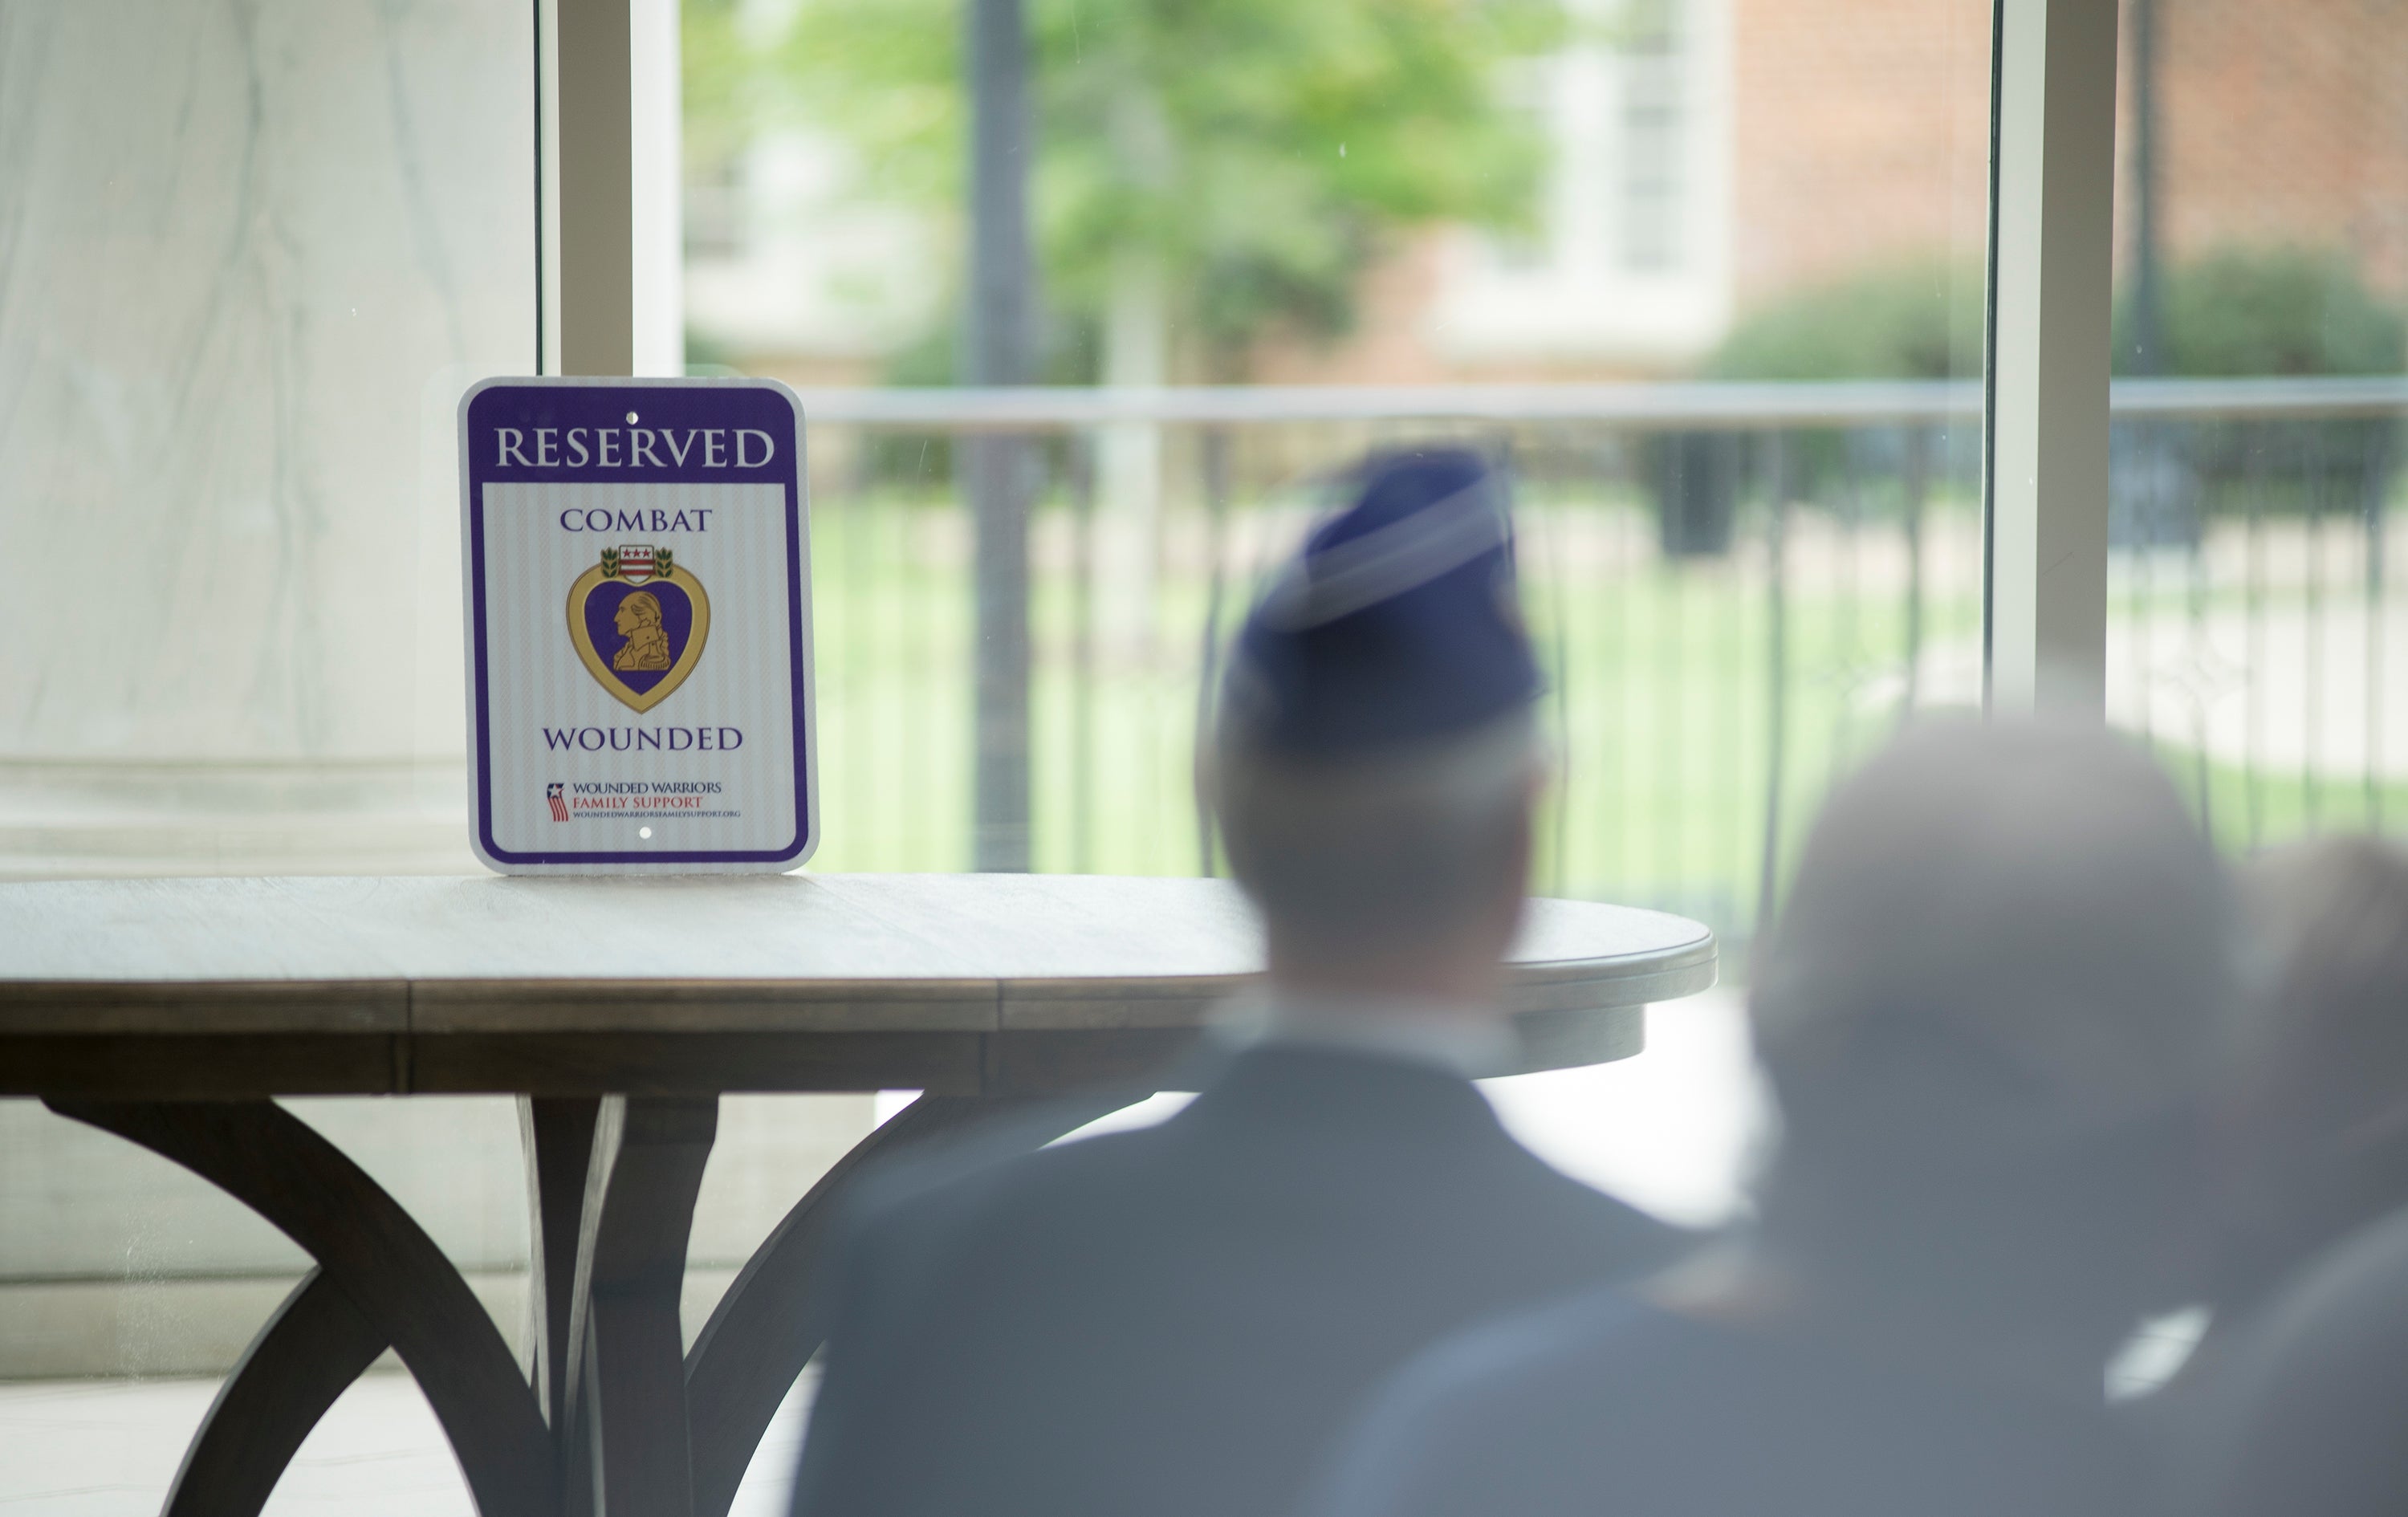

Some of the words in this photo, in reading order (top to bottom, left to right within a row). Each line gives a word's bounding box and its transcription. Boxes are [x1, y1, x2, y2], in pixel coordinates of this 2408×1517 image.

[494, 428, 775, 468] RESERVED
[560, 509, 713, 532] COMBAT
[543, 727, 743, 751] WOUNDED
[573, 783, 649, 795] WOUNDED
[651, 782, 722, 794] WARRIORS
[573, 797, 628, 808] FAMILY
[633, 797, 703, 808] SUPPORT
[573, 811, 741, 819] WOUNDEDWARRIORSFAMILYSUPPORT.ORG
